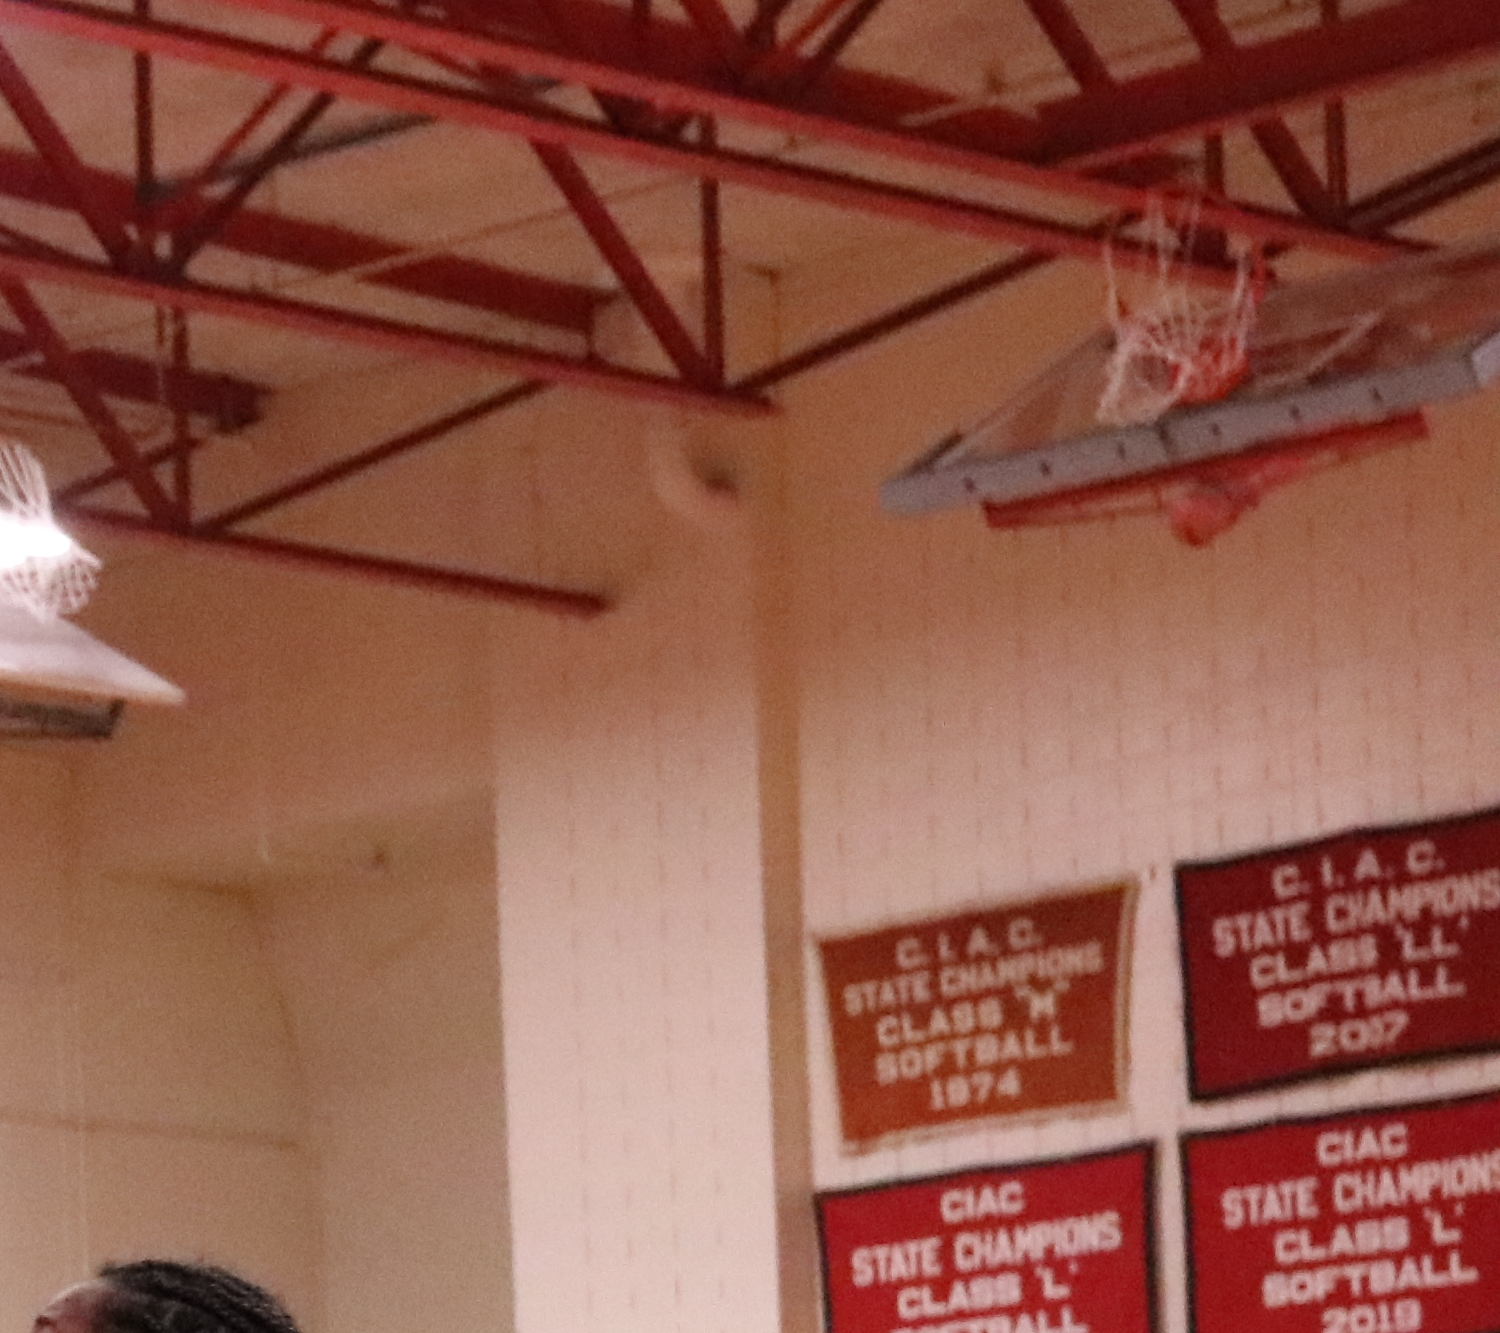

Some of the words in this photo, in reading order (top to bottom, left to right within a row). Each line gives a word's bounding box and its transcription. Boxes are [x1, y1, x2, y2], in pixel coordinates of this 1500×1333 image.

[1212, 901, 1309, 958] STATE
[844, 974, 933, 1017] STATE
[939, 940, 1105, 996] CHAMPIONS
[1249, 935, 1379, 990] CLASS
[1256, 966, 1467, 1028] SOFTBALL
[876, 1000, 1004, 1048] CLASS
[1308, 1011, 1410, 1057] 2017
[876, 1028, 1074, 1085] SOFTBALL
[929, 1070, 1022, 1112] 1974
[1316, 1123, 1409, 1167] CIAC
[940, 1181, 1025, 1224] CIAC
[1220, 1177, 1318, 1230] STATE
[851, 1232, 942, 1287] STATE
[954, 1211, 1122, 1267] CHAMPIONS
[1274, 1219, 1409, 1266] CLASS
[897, 1270, 1021, 1320] CLASS
[1262, 1251, 1479, 1309] SOFTBALL
